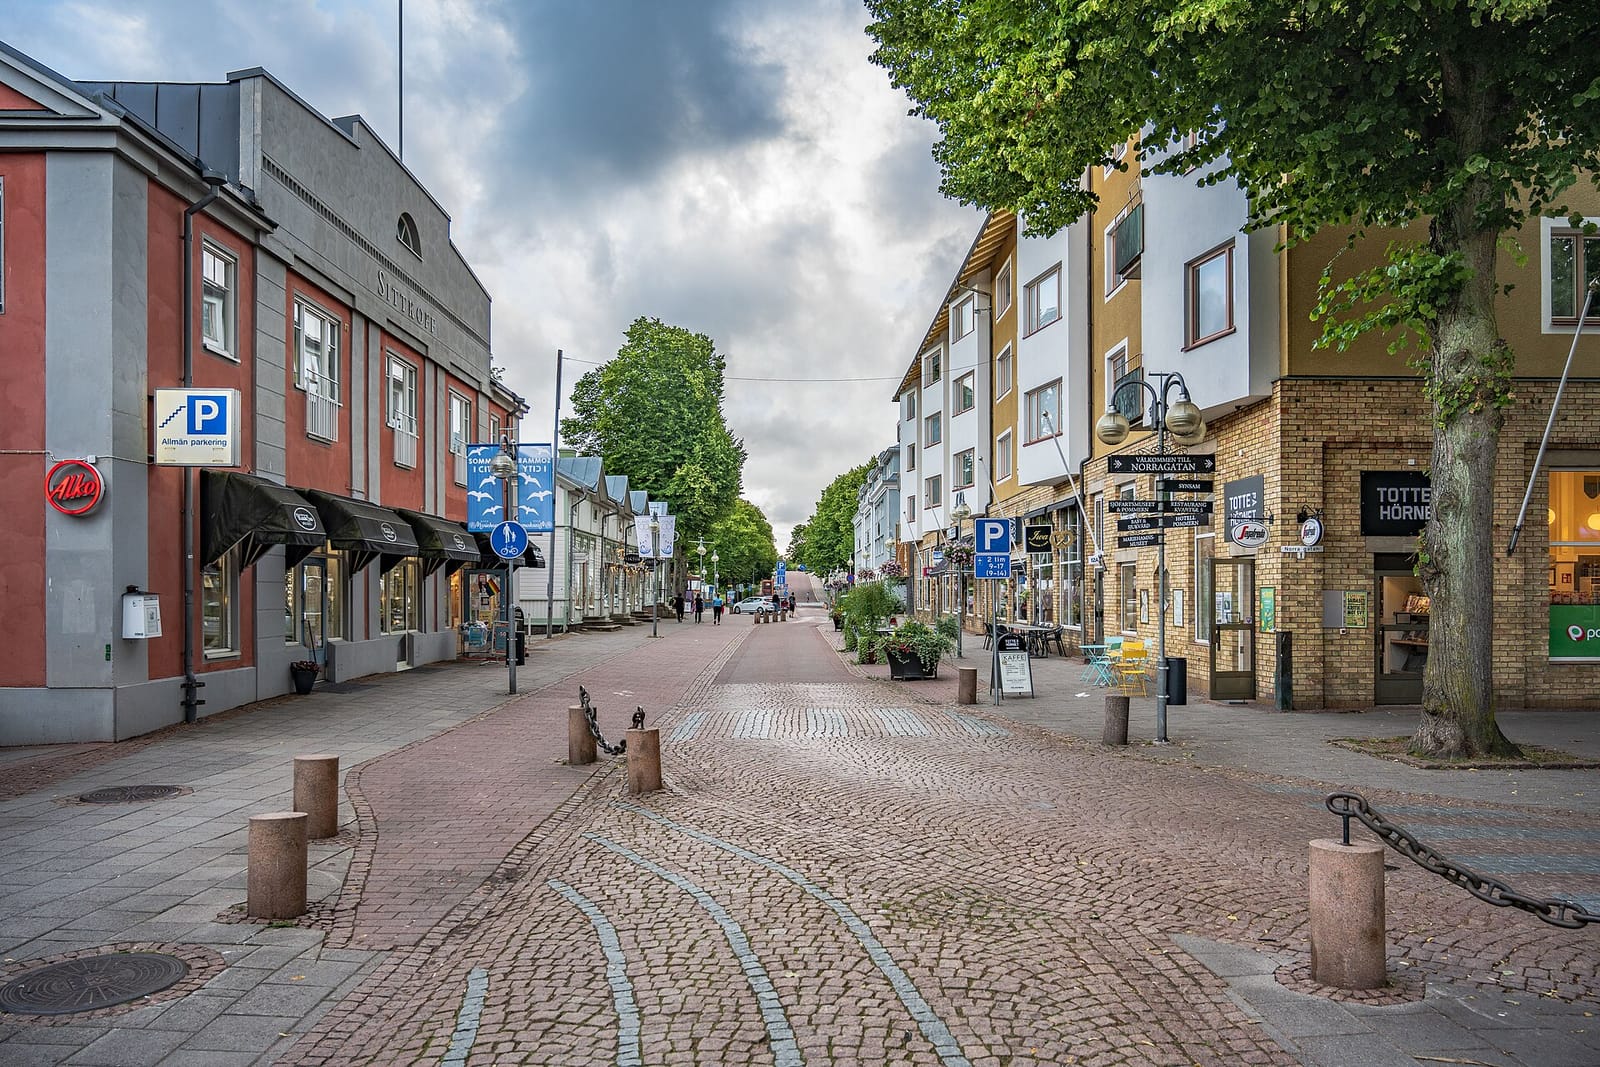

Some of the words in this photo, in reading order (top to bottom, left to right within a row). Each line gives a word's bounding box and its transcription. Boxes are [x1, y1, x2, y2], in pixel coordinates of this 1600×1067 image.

[377, 270, 436, 333] SITTKOFF
[195, 399, 219, 431] P
[162, 438, 188, 446] Allmän
[190, 438, 227, 447] parkering
[1131, 463, 1195, 471] NORRAGATAN
[50, 472, 96, 500] Alko
[1377, 487, 1432, 503] TOTTE
[985, 522, 1004, 551] P
